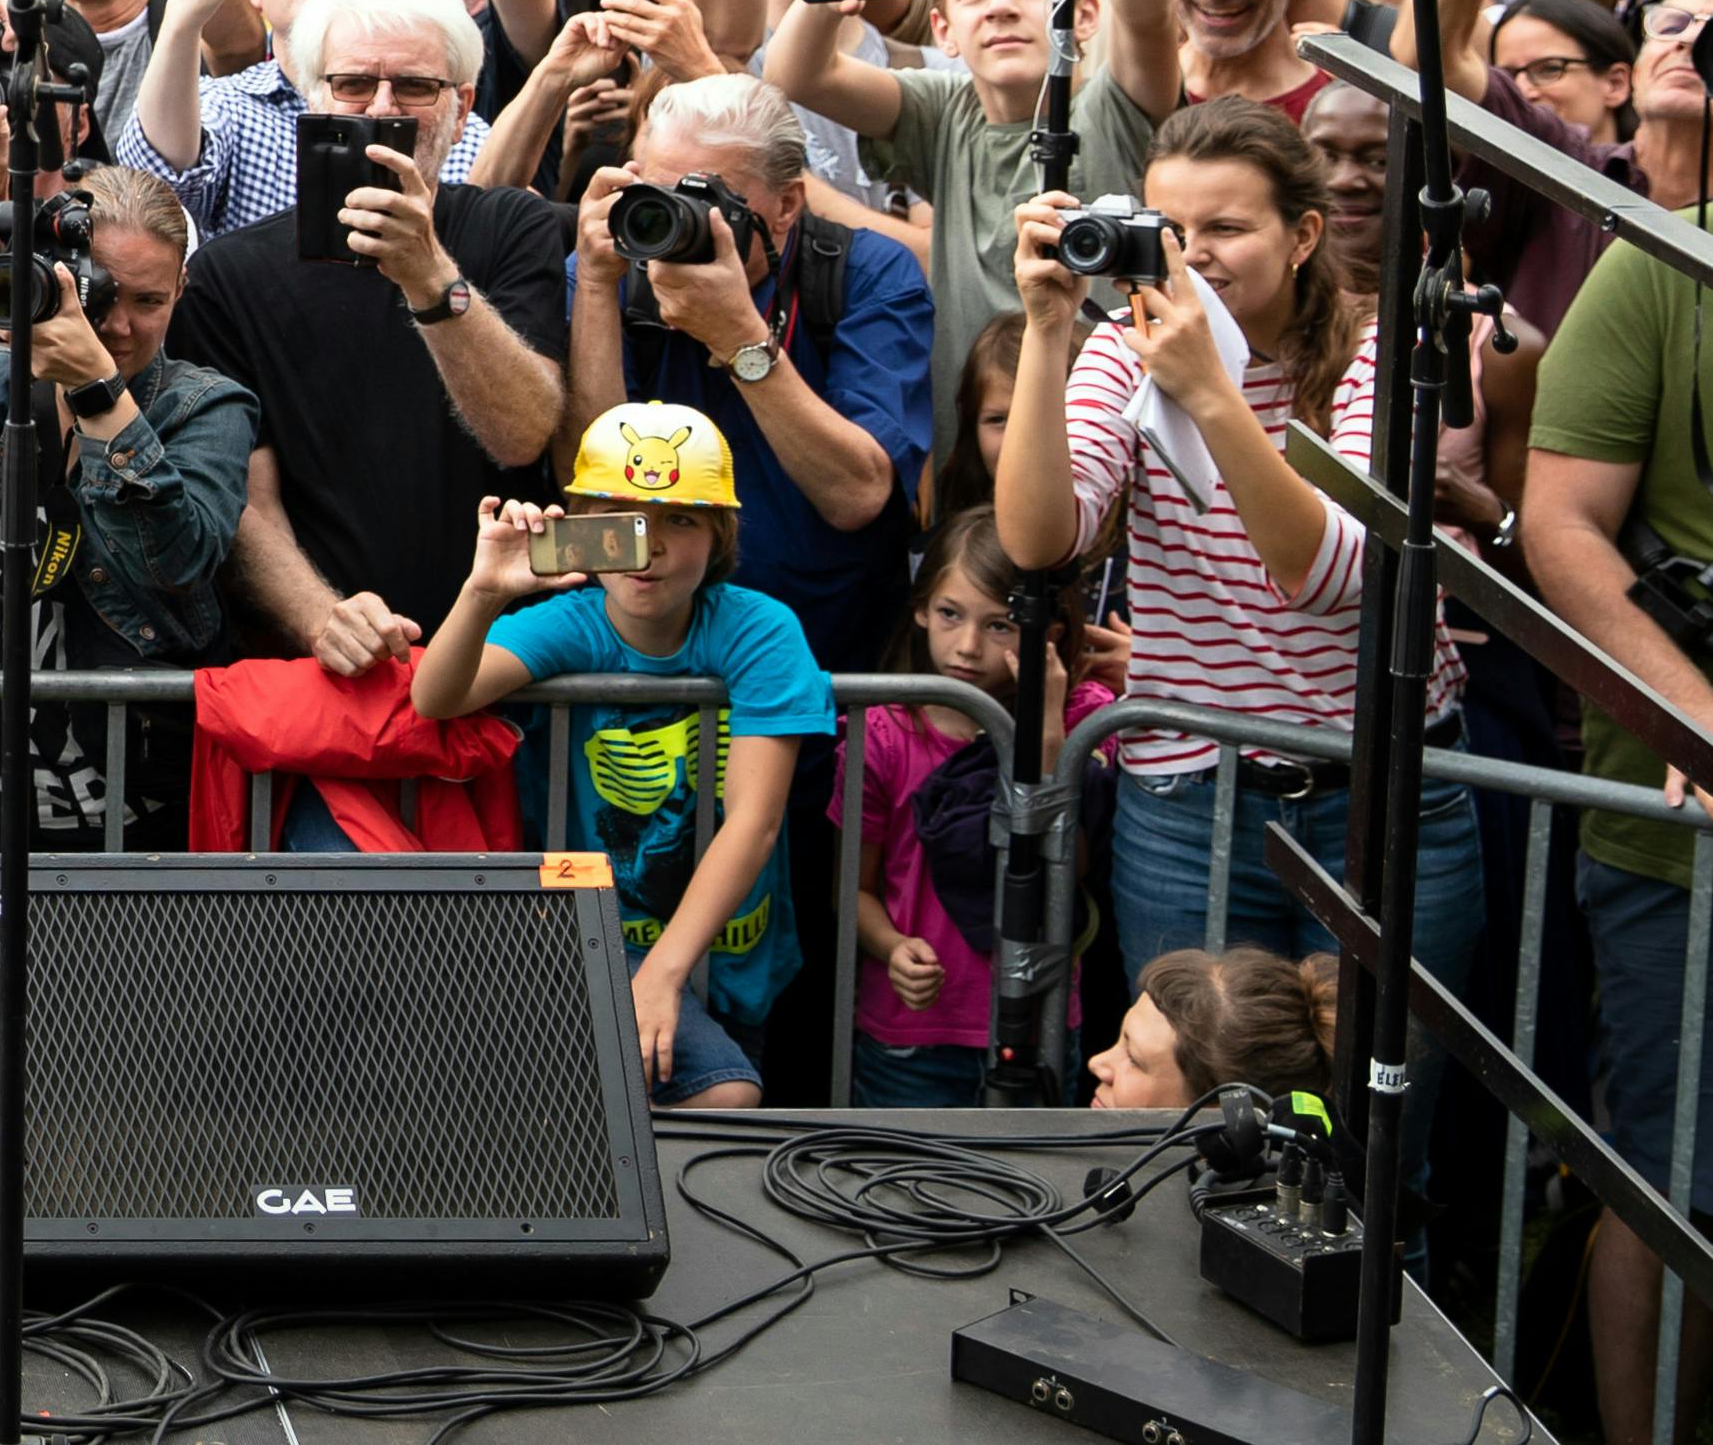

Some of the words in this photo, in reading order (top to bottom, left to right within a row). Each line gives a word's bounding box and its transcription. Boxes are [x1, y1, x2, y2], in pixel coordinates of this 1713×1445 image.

[680, 178, 708, 189] Canon
[77, 275, 92, 308] Nikon
[42, 529, 73, 586] Nikon
[557, 859, 577, 879] 2
[256, 1187, 357, 1216] GAE
